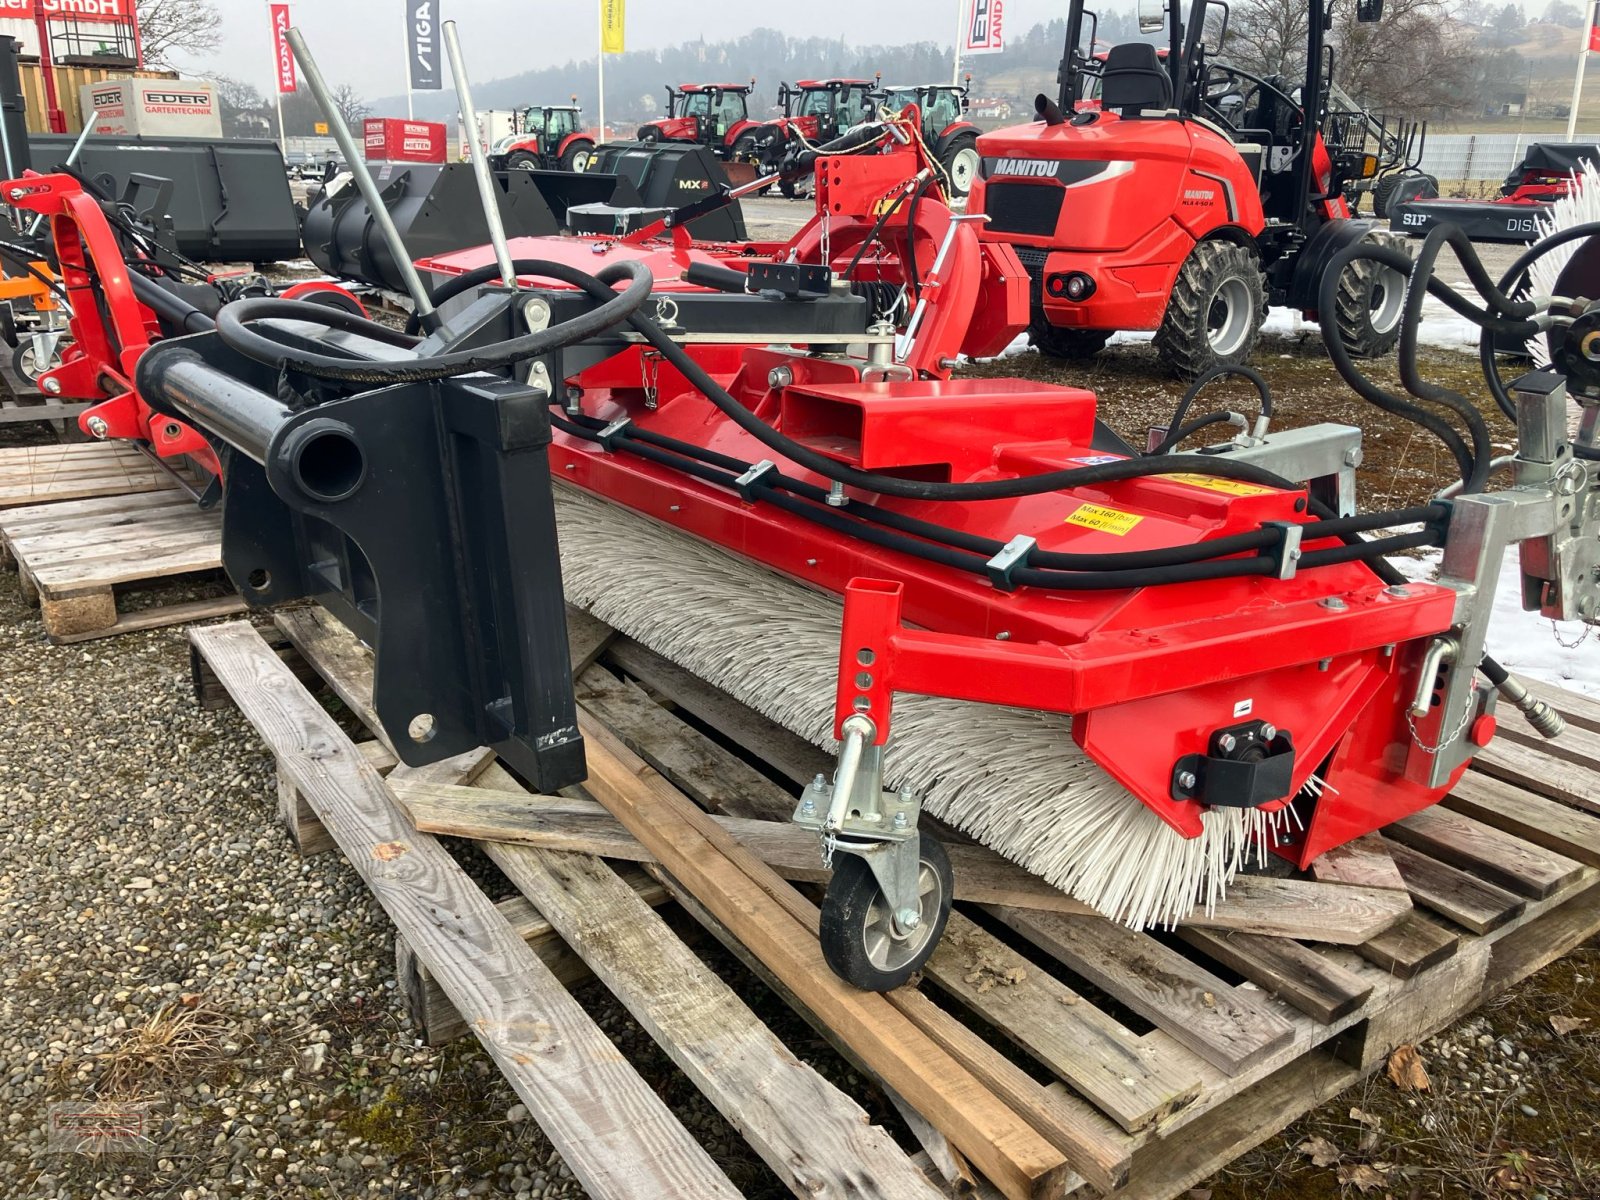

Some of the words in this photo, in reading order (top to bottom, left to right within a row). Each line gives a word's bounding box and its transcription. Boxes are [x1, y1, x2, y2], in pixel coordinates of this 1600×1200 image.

[43, 0, 119, 15] GmbH
[415, 1, 432, 72] STIGA
[276, 9, 293, 87] HONDA
[93, 91, 122, 105] EDER
[145, 93, 208, 104] EDER
[145, 106, 212, 115] GARTENTECHNIK
[994, 159, 1060, 177] MANITOU
[679, 180, 701, 189] MX
[1184, 190, 1214, 200] MANITOU
[1402, 213, 1427, 226] SIP
[1080, 505, 1098, 515] Max
[1099, 510, 1116, 518] 160
[1070, 514, 1088, 523] Max
[1088, 518, 1101, 526] 60
